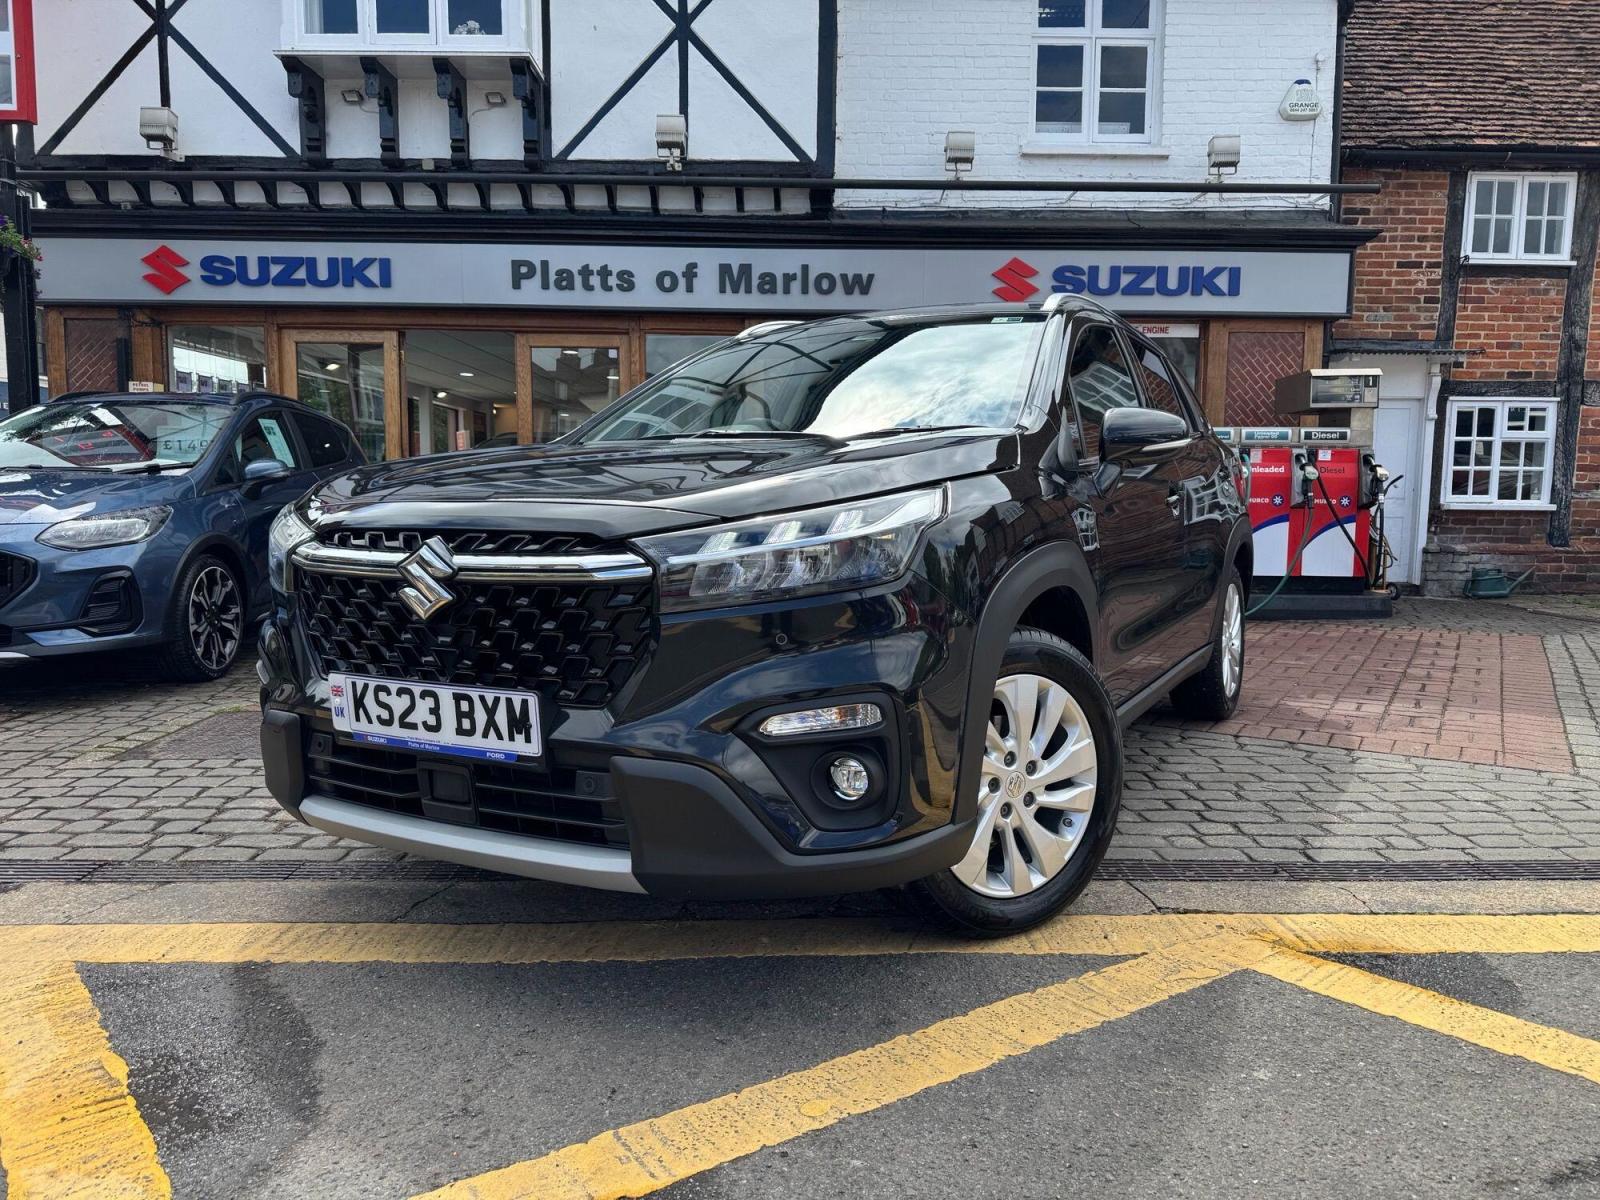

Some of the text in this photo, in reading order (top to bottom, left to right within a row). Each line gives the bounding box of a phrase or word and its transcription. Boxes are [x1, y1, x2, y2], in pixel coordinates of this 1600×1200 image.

[200, 255, 392, 288] SUZUKI
[510, 259, 875, 295] Platts of Marlow
[1051, 264, 1242, 297] SUZUKI
[1142, 326, 1170, 334] ENGINE
[1311, 431, 1340, 440] Diesel
[1319, 466, 1345, 474] Diesel
[334, 706, 346, 718] UK
[351, 681, 533, 744] KS23 BXM
[486, 751, 505, 759] FORD
